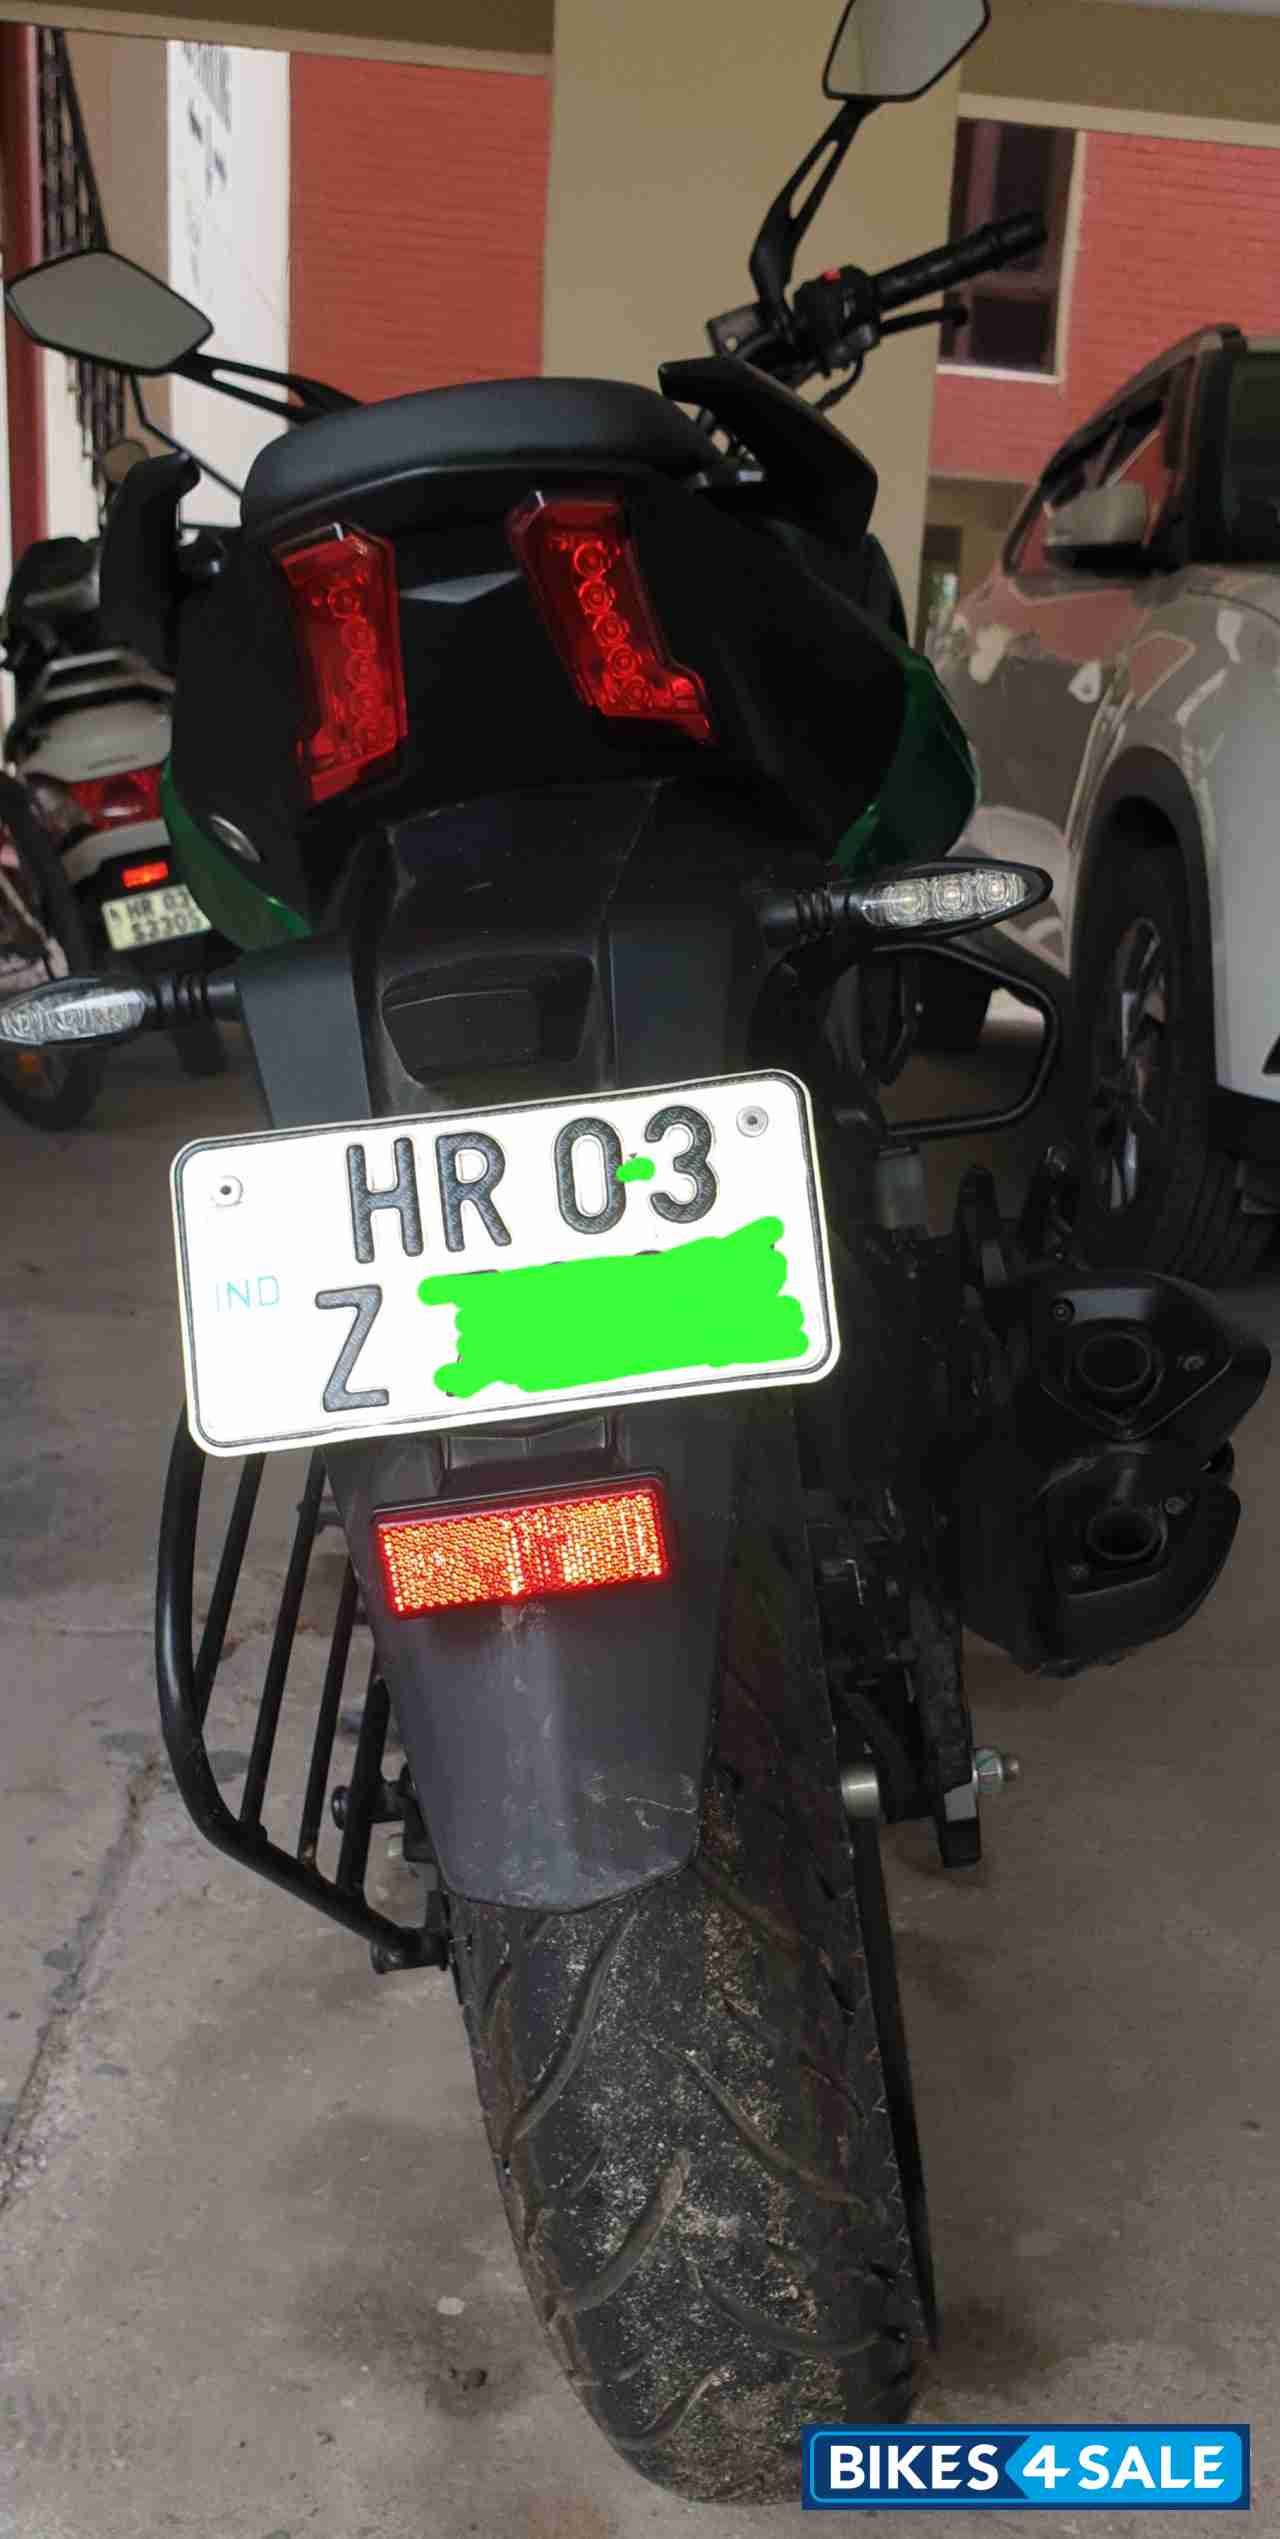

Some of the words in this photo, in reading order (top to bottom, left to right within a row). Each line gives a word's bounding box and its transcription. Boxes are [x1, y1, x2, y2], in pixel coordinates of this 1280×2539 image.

[346, 1132, 512, 1264] HR
[554, 1105, 718, 1235] 03
[215, 1275, 281, 1312] IND
[315, 1283, 390, 1412] Z
